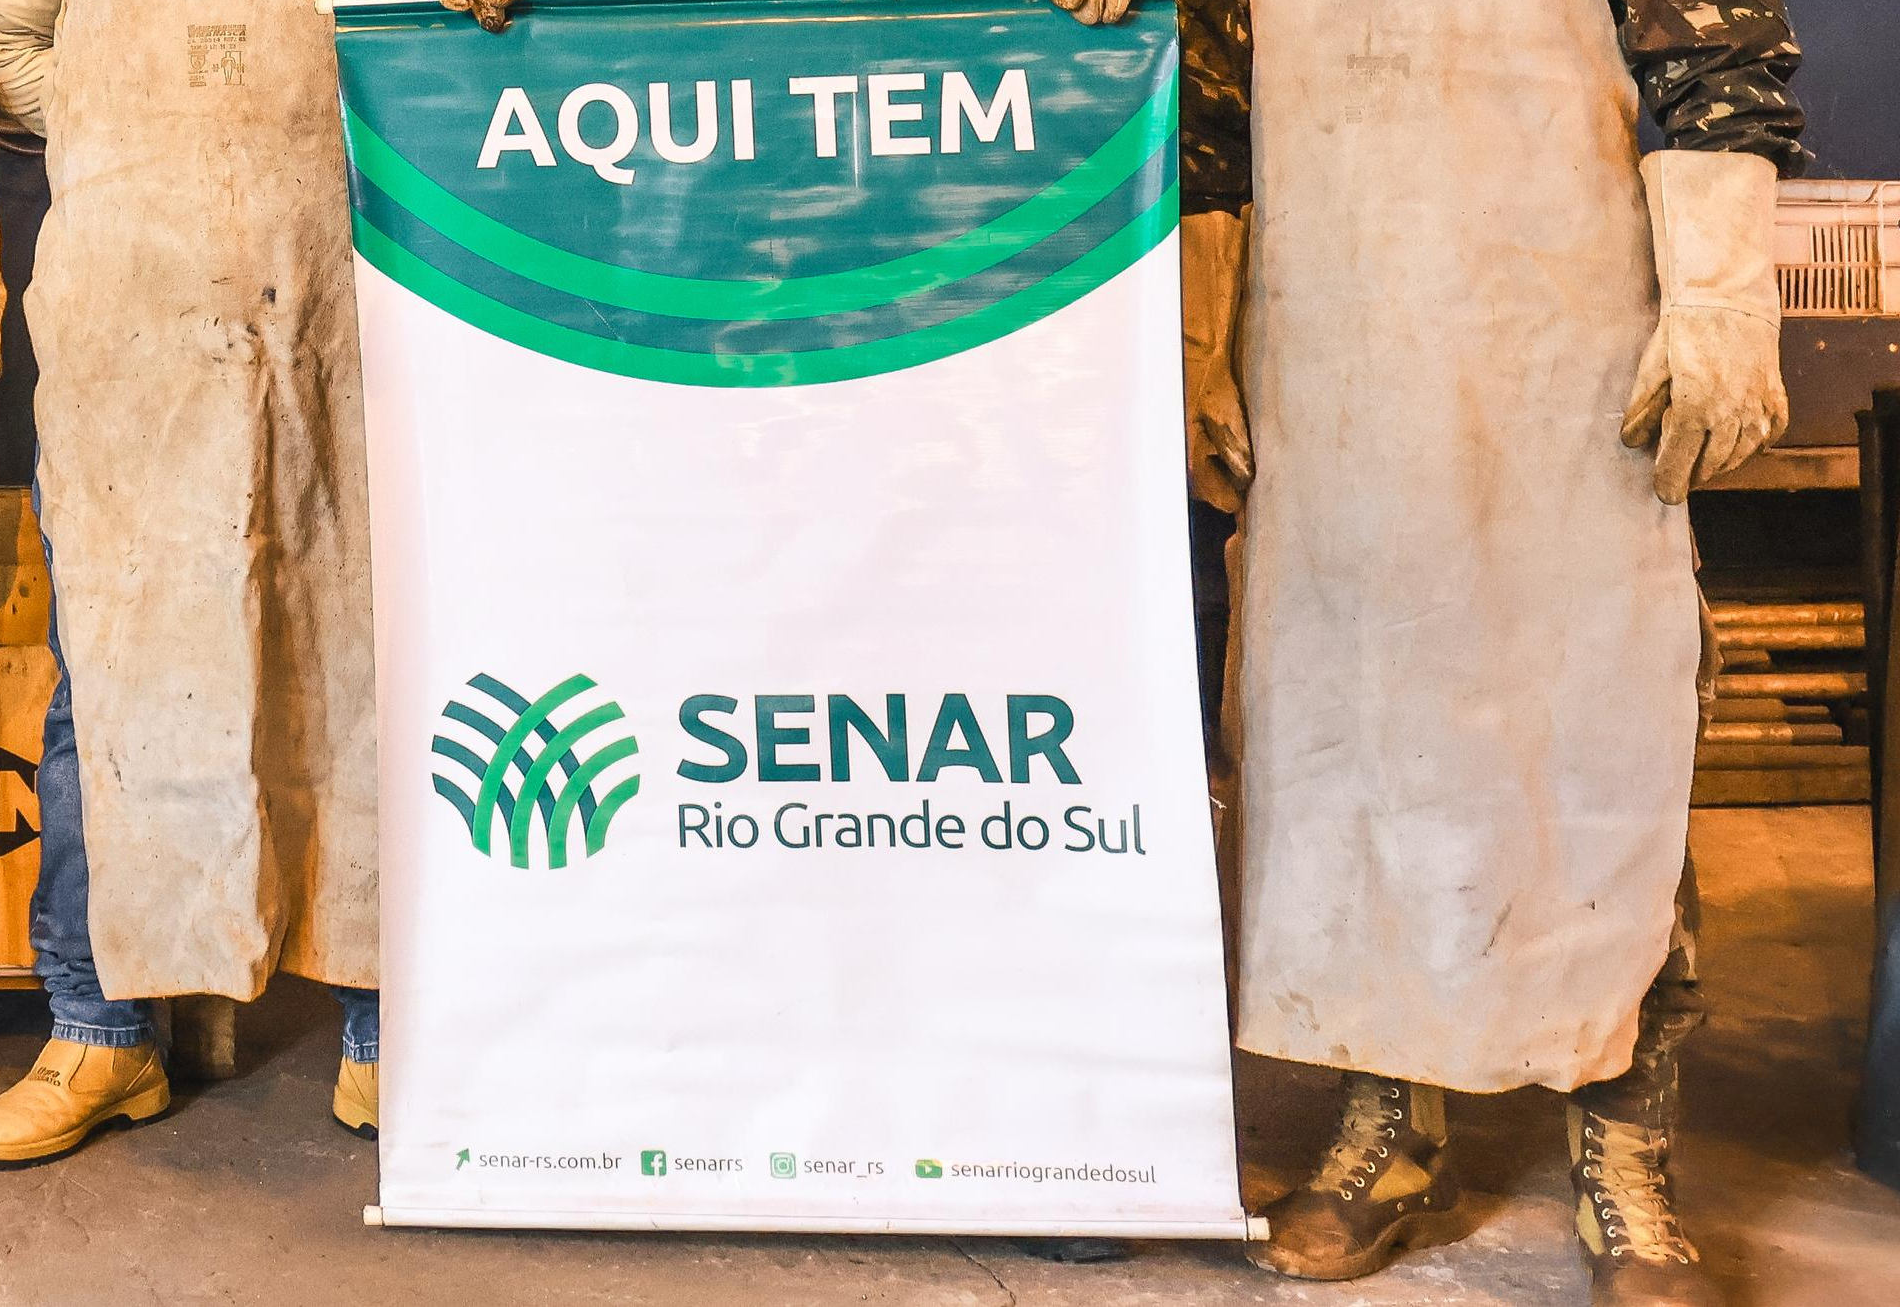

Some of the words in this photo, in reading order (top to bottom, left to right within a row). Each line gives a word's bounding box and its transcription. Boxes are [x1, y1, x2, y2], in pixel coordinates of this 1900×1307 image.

[477, 79, 755, 185] AQUI
[789, 69, 1036, 158] TEM
[676, 693, 1083, 784] SENAR
[678, 801, 759, 849] Rio
[773, 801, 966, 849] Grande
[981, 800, 1049, 850] do
[1064, 804, 1146, 856] Sul
[479, 1152, 622, 1171] senar-rs.com.br
[674, 1157, 744, 1172] senarrs
[804, 1159, 885, 1178] senar_rs
[951, 1161, 1158, 1184] senarriograndedosul
